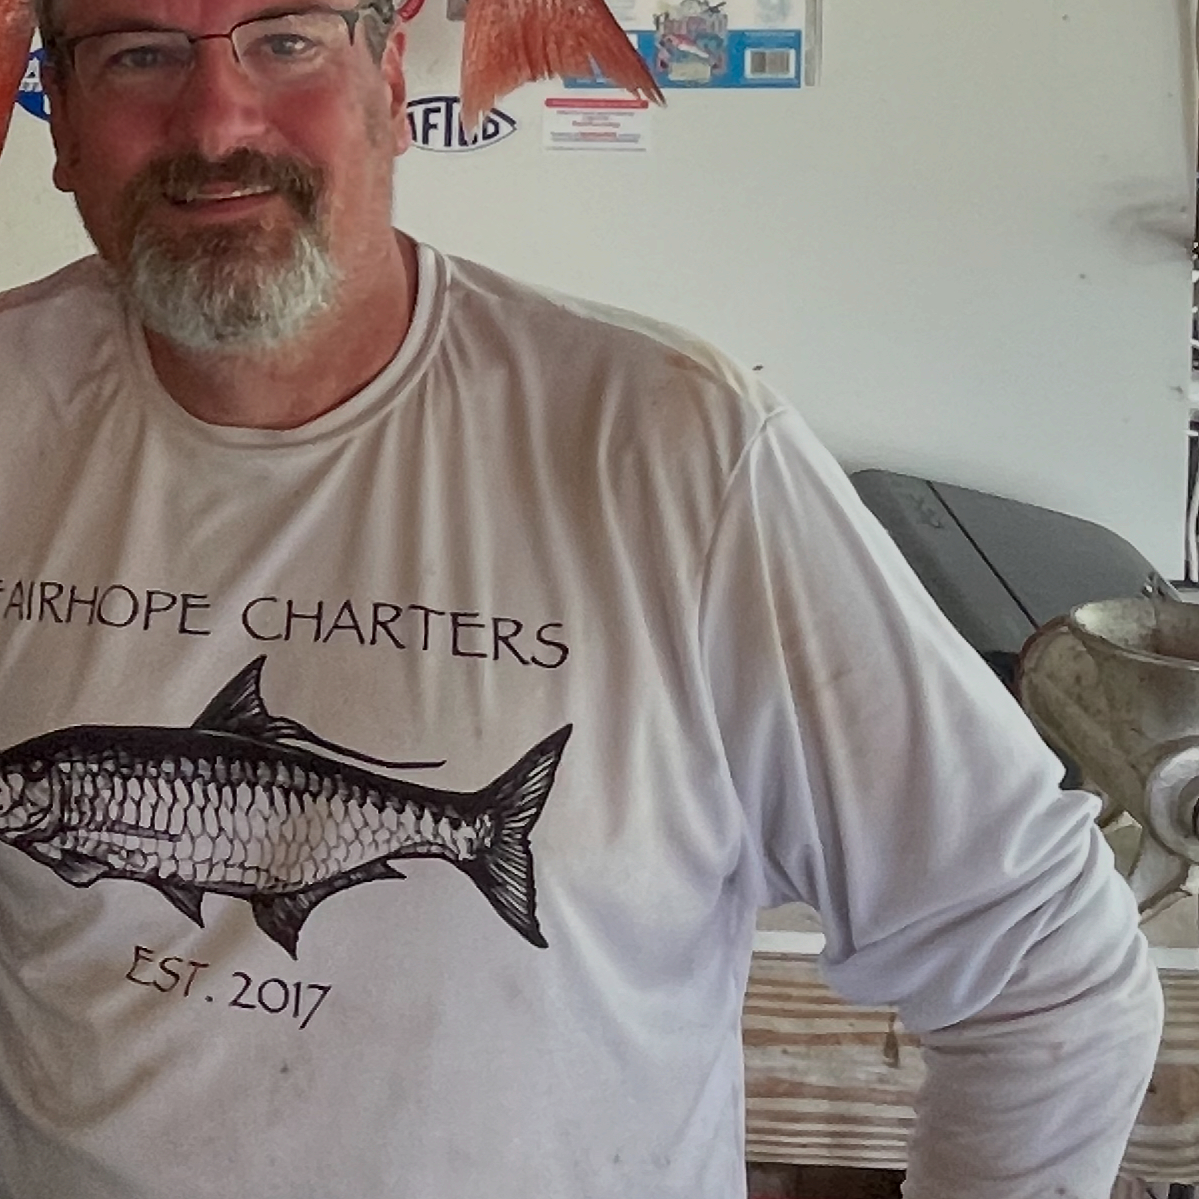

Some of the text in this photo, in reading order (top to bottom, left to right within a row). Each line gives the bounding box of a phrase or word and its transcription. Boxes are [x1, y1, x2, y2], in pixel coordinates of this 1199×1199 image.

[241, 596, 570, 669] CHARTERS
[125, 944, 333, 1031] EST. 2017
